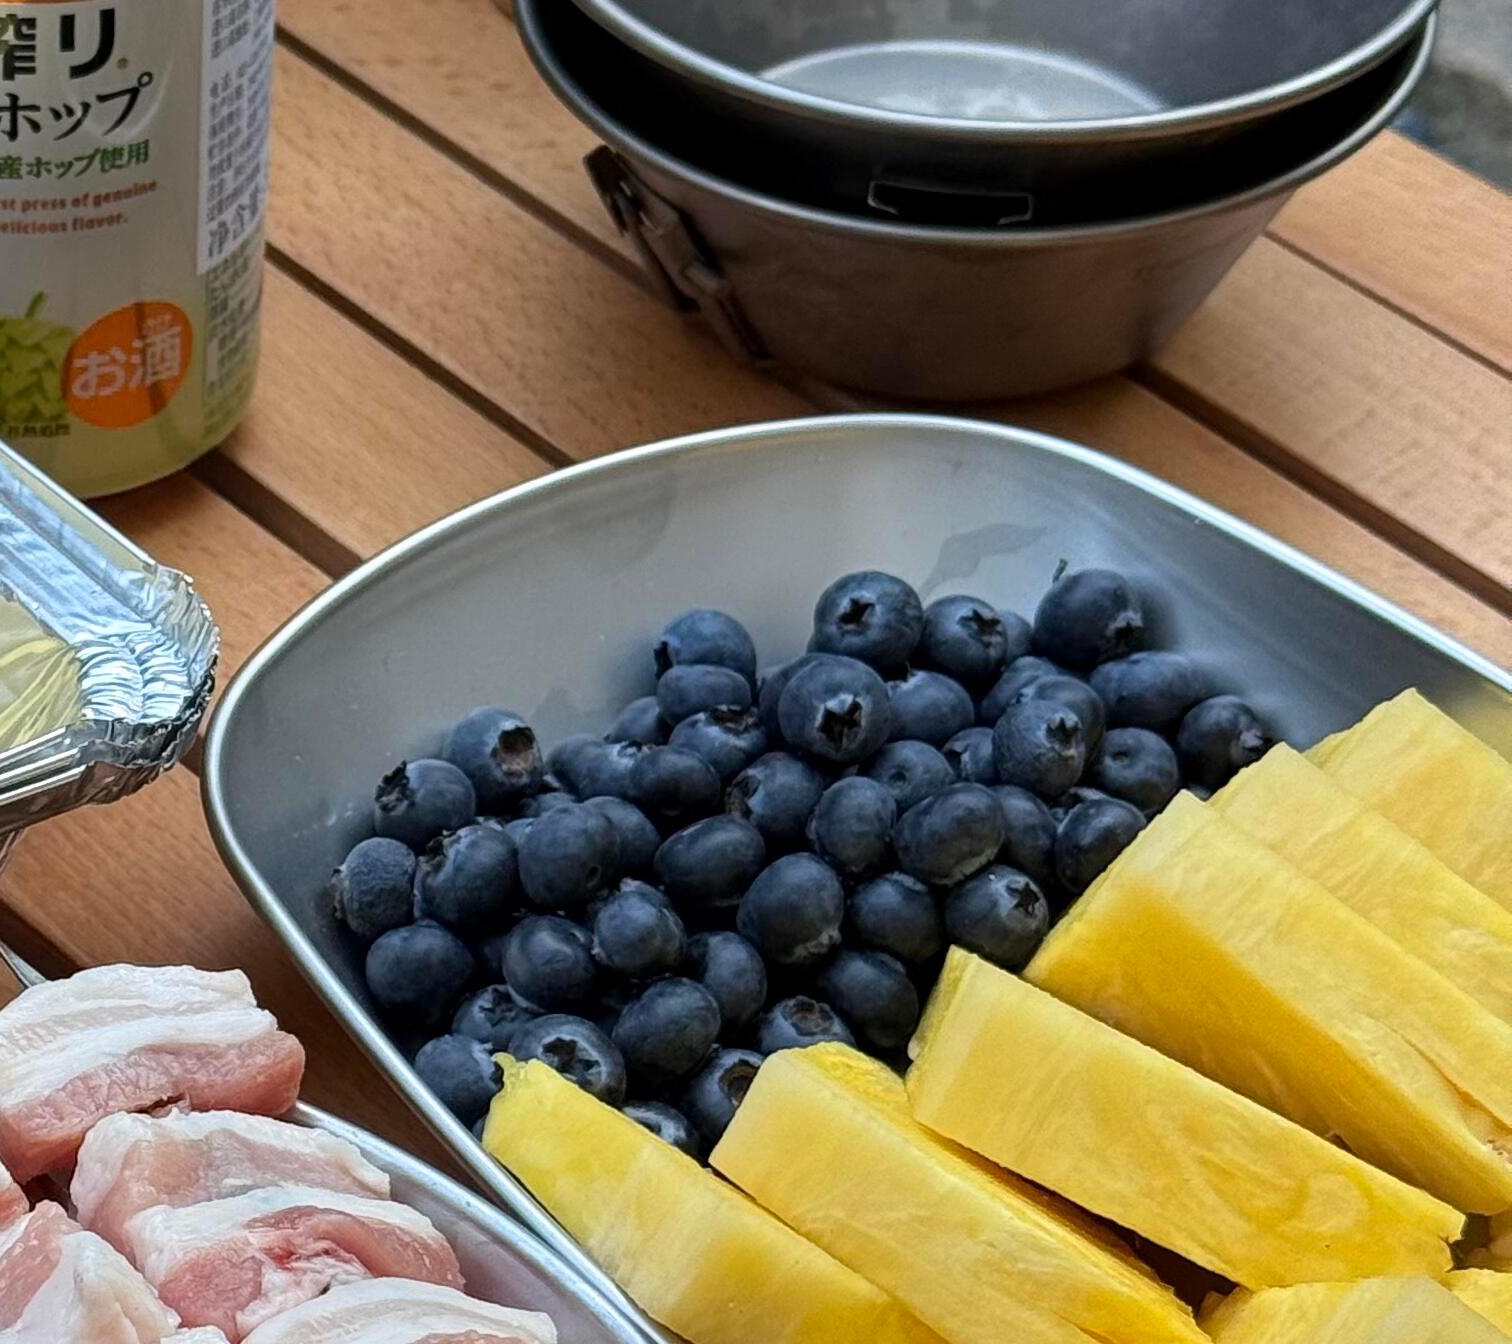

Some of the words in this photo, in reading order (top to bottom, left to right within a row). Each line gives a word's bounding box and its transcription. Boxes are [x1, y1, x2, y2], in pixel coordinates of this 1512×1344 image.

[19, 196, 67, 214] press
[70, 191, 92, 210] of
[91, 179, 159, 209] genuine
[70, 211, 129, 233] flavor.
[71, 326, 185, 400] お酒
